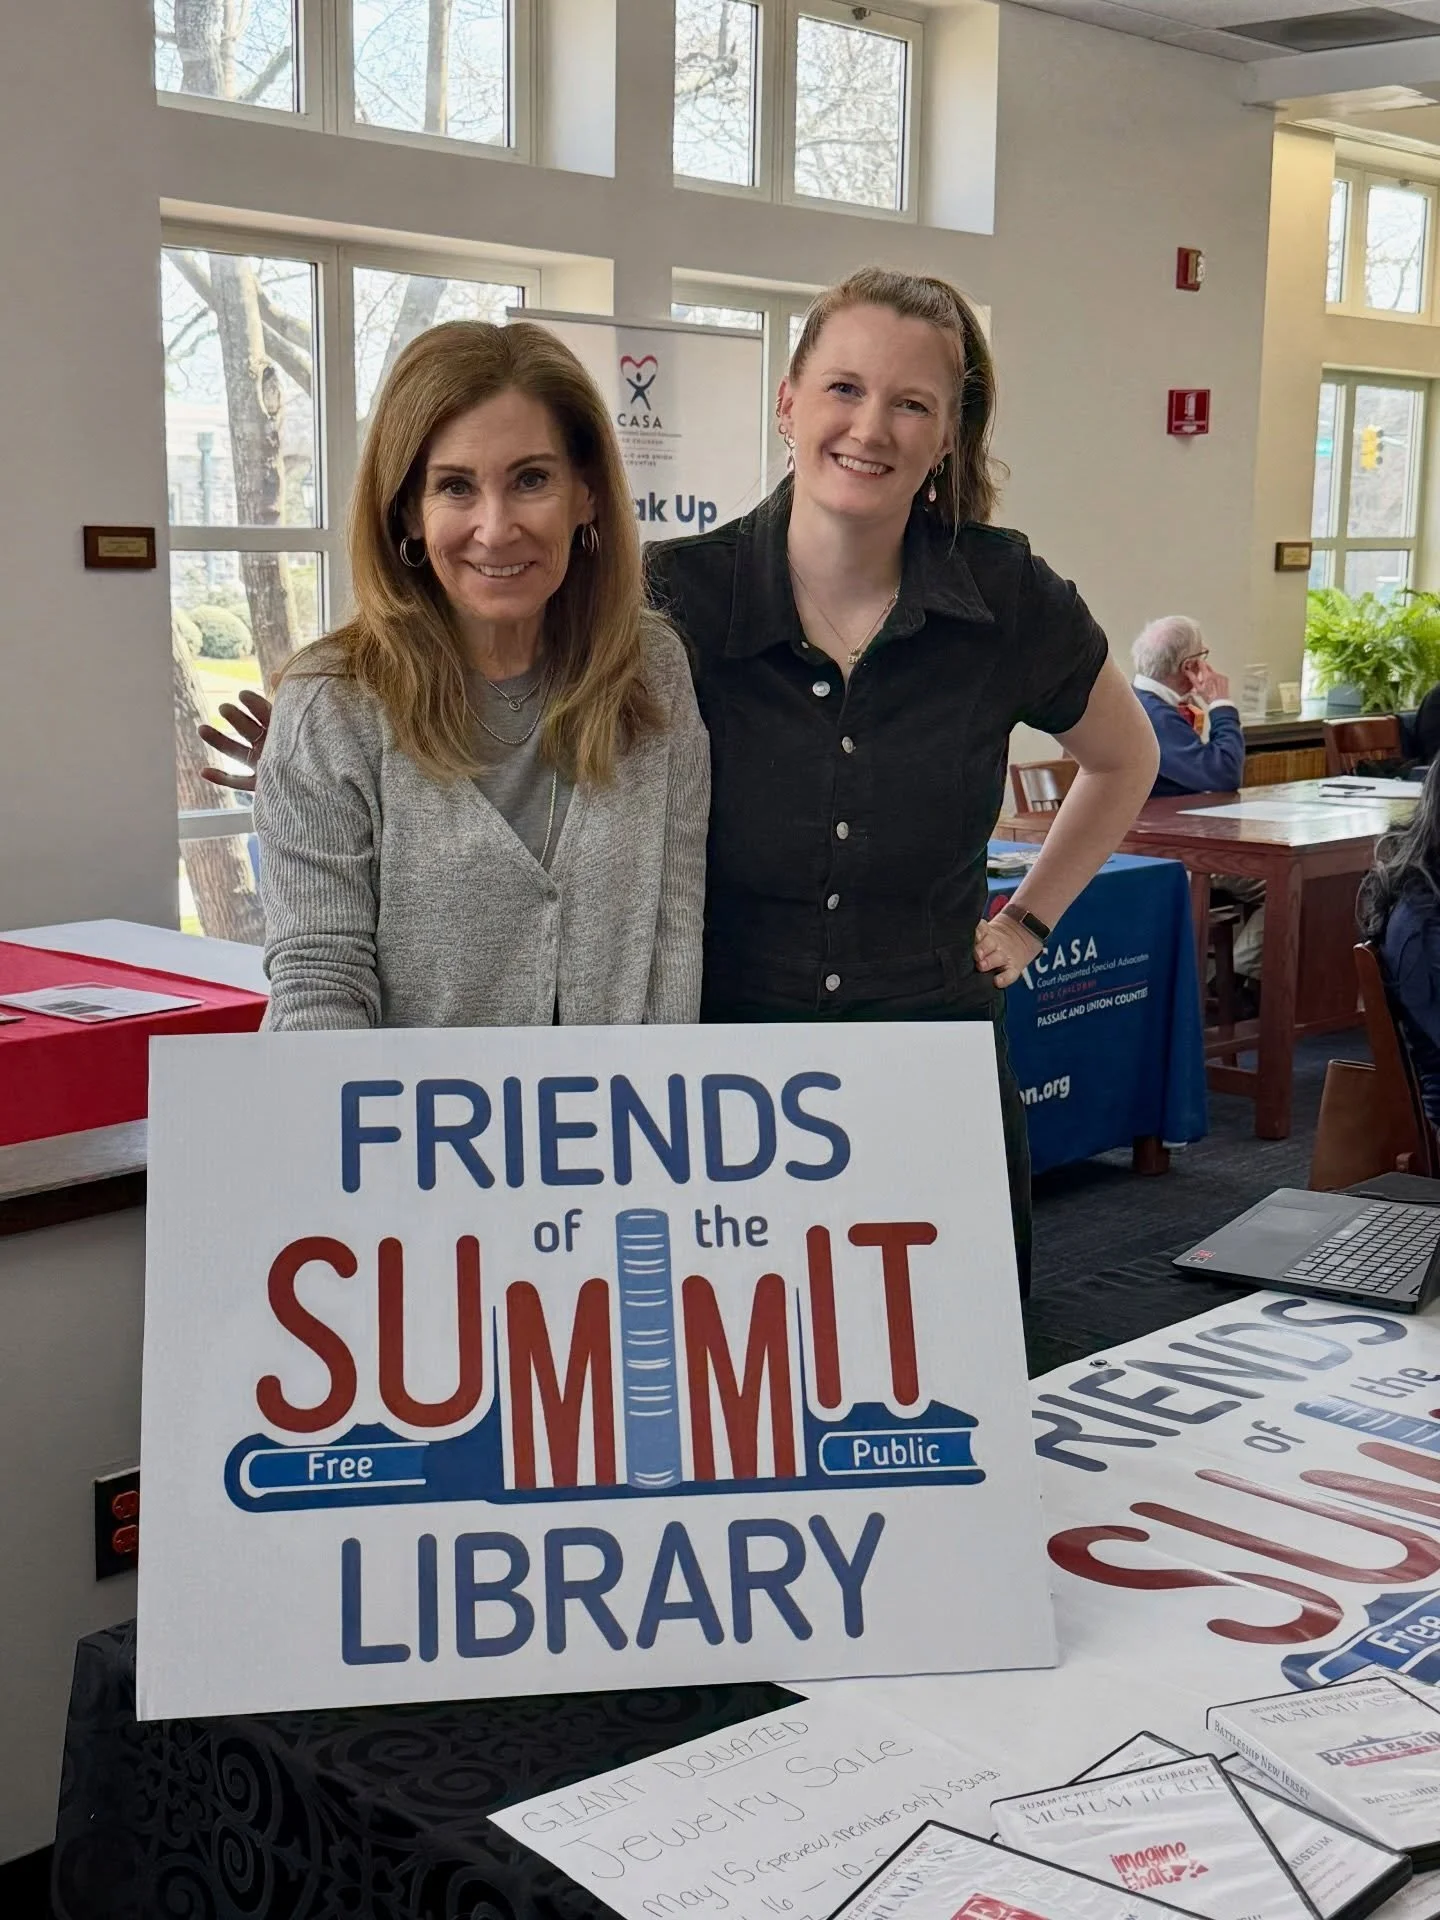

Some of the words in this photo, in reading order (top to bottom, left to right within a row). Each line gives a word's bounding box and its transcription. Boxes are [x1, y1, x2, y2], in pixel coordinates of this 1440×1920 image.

[616, 413, 663, 429] CASA
[675, 494, 718, 533] Up
[1034, 935, 1098, 974] CASA
[1036, 976, 1057, 989] Court
[1057, 966, 1091, 984] Appointed
[1091, 959, 1117, 973] Special
[1037, 1009, 1067, 1028] PASSAIC
[1068, 1004, 1085, 1019] AND
[1086, 997, 1113, 1013] UNION
[341, 1071, 851, 1193] FRIENDS
[533, 1208, 583, 1254] of
[694, 1205, 769, 1250] the
[255, 1221, 938, 1491] SUMMIT
[1242, 1419, 1305, 1454] of
[1350, 1367, 1440, 1399] the
[307, 1450, 374, 1481] Free
[852, 1436, 941, 1467] Public
[341, 1511, 886, 1667] LIBRARY
[522, 1775, 647, 1834] GIANT
[653, 1720, 809, 1780] DONATED
[1215, 1719, 1260, 1762] BATTLESHIP
[1261, 1755, 1280, 1778] NEW
[1281, 1770, 1311, 1801] JERSEY
[1018, 1794, 1070, 1811] SUMMIT
[1158, 1764, 1209, 1782] LIBRARY
[1025, 1794, 1132, 1826] MUSEUM
[560, 1788, 806, 1880] Jewelry
[1109, 1840, 1187, 1874] imagine
[642, 1884, 729, 1918] May
[711, 1861, 756, 1887] 15
[831, 1809, 901, 1845] members
[760, 1895, 794, 1914] 16
